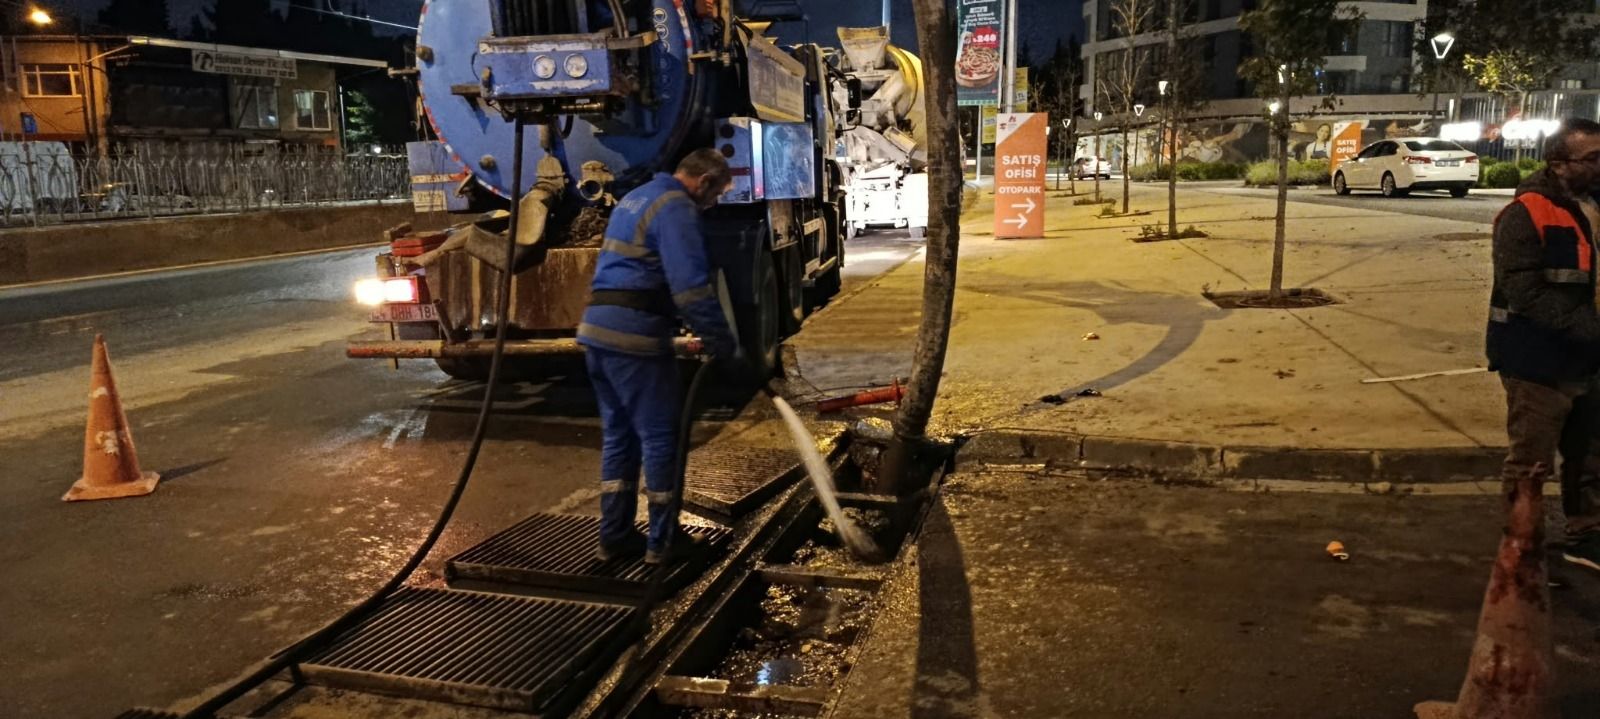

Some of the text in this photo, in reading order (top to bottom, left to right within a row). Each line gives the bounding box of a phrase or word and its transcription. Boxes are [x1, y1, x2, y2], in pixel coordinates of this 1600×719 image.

[1002, 154, 1042, 167] SATIŞ
[1005, 166, 1036, 178] OFİSİ
[999, 186, 1042, 194] OTOPARK
